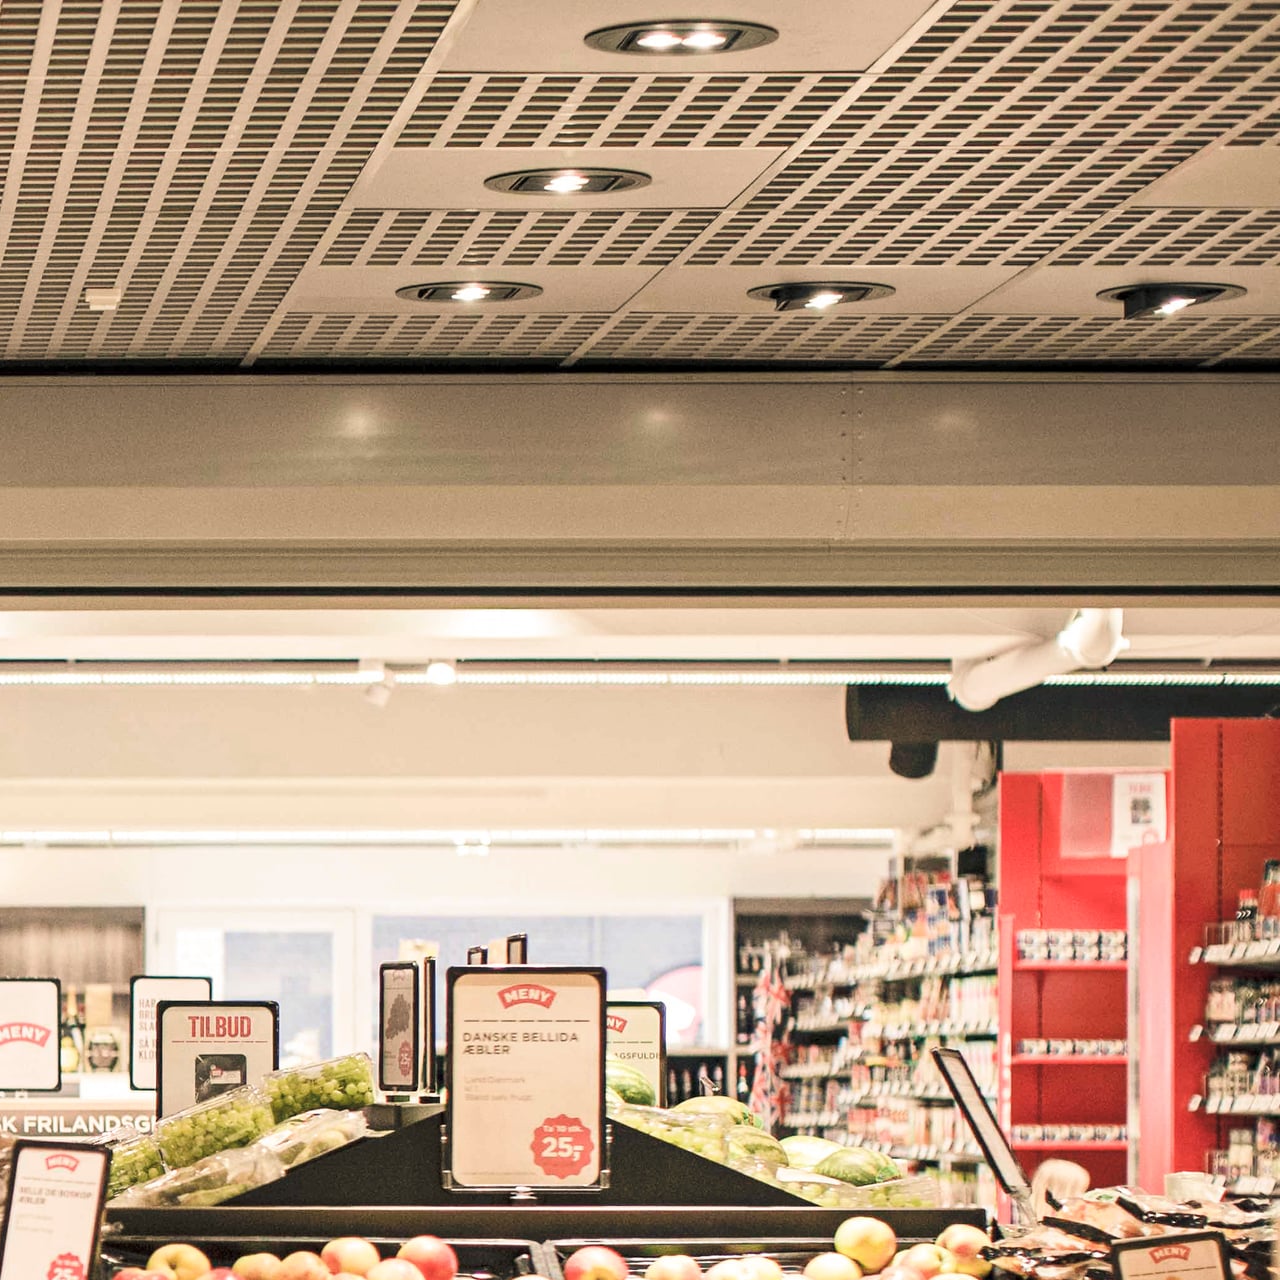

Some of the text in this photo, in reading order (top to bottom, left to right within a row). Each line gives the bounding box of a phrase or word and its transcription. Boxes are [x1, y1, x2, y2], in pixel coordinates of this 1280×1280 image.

[503, 988, 551, 1003] MENY
[139, 1021, 154, 1031] SLA
[188, 1015, 252, 1038] TILBUD
[607, 1016, 623, 1028] NY
[463, 1032, 579, 1042] DANSKE BELLIDA
[138, 1049, 155, 1060] KLO
[463, 1045, 510, 1055] ÆBLER
[1154, 1247, 1187, 1260] MENY
